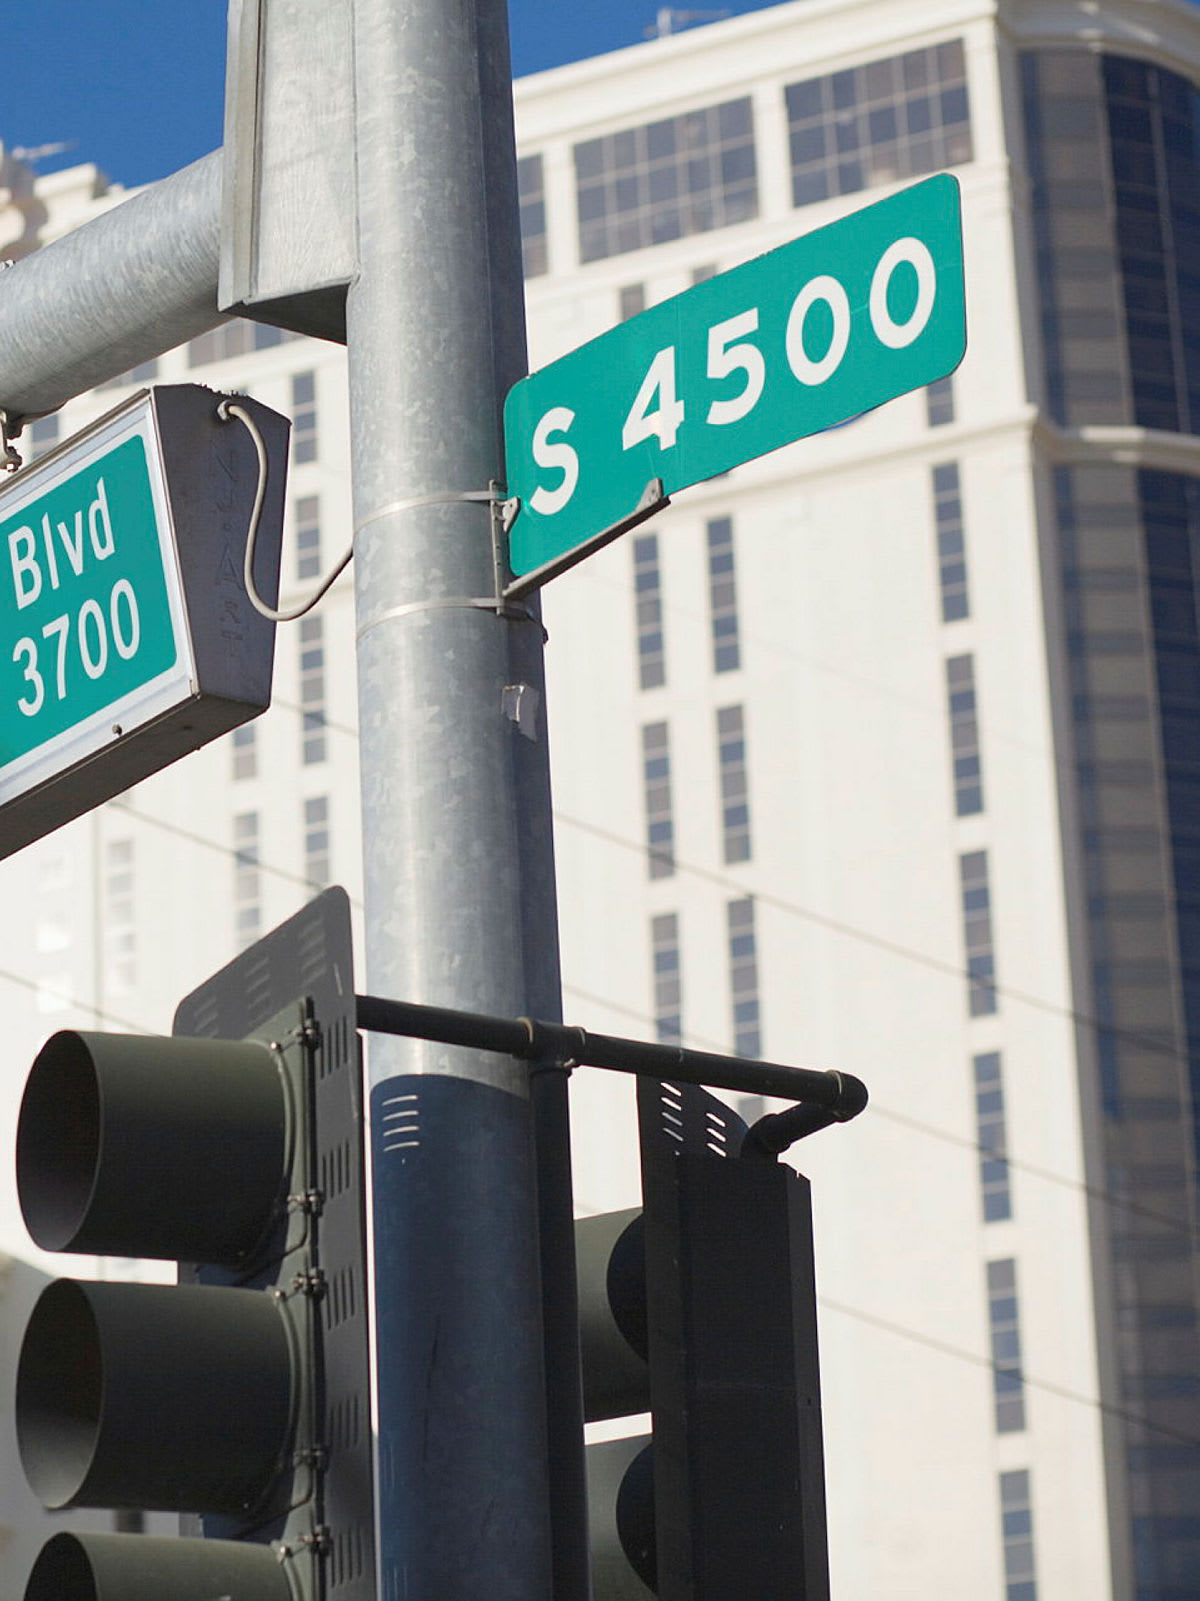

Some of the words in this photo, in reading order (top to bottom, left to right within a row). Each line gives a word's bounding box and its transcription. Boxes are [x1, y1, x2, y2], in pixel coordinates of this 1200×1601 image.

[529, 406, 579, 516] S
[621, 236, 937, 451] 4500
[7, 477, 115, 611] Blvd
[12, 578, 141, 717] 3700
